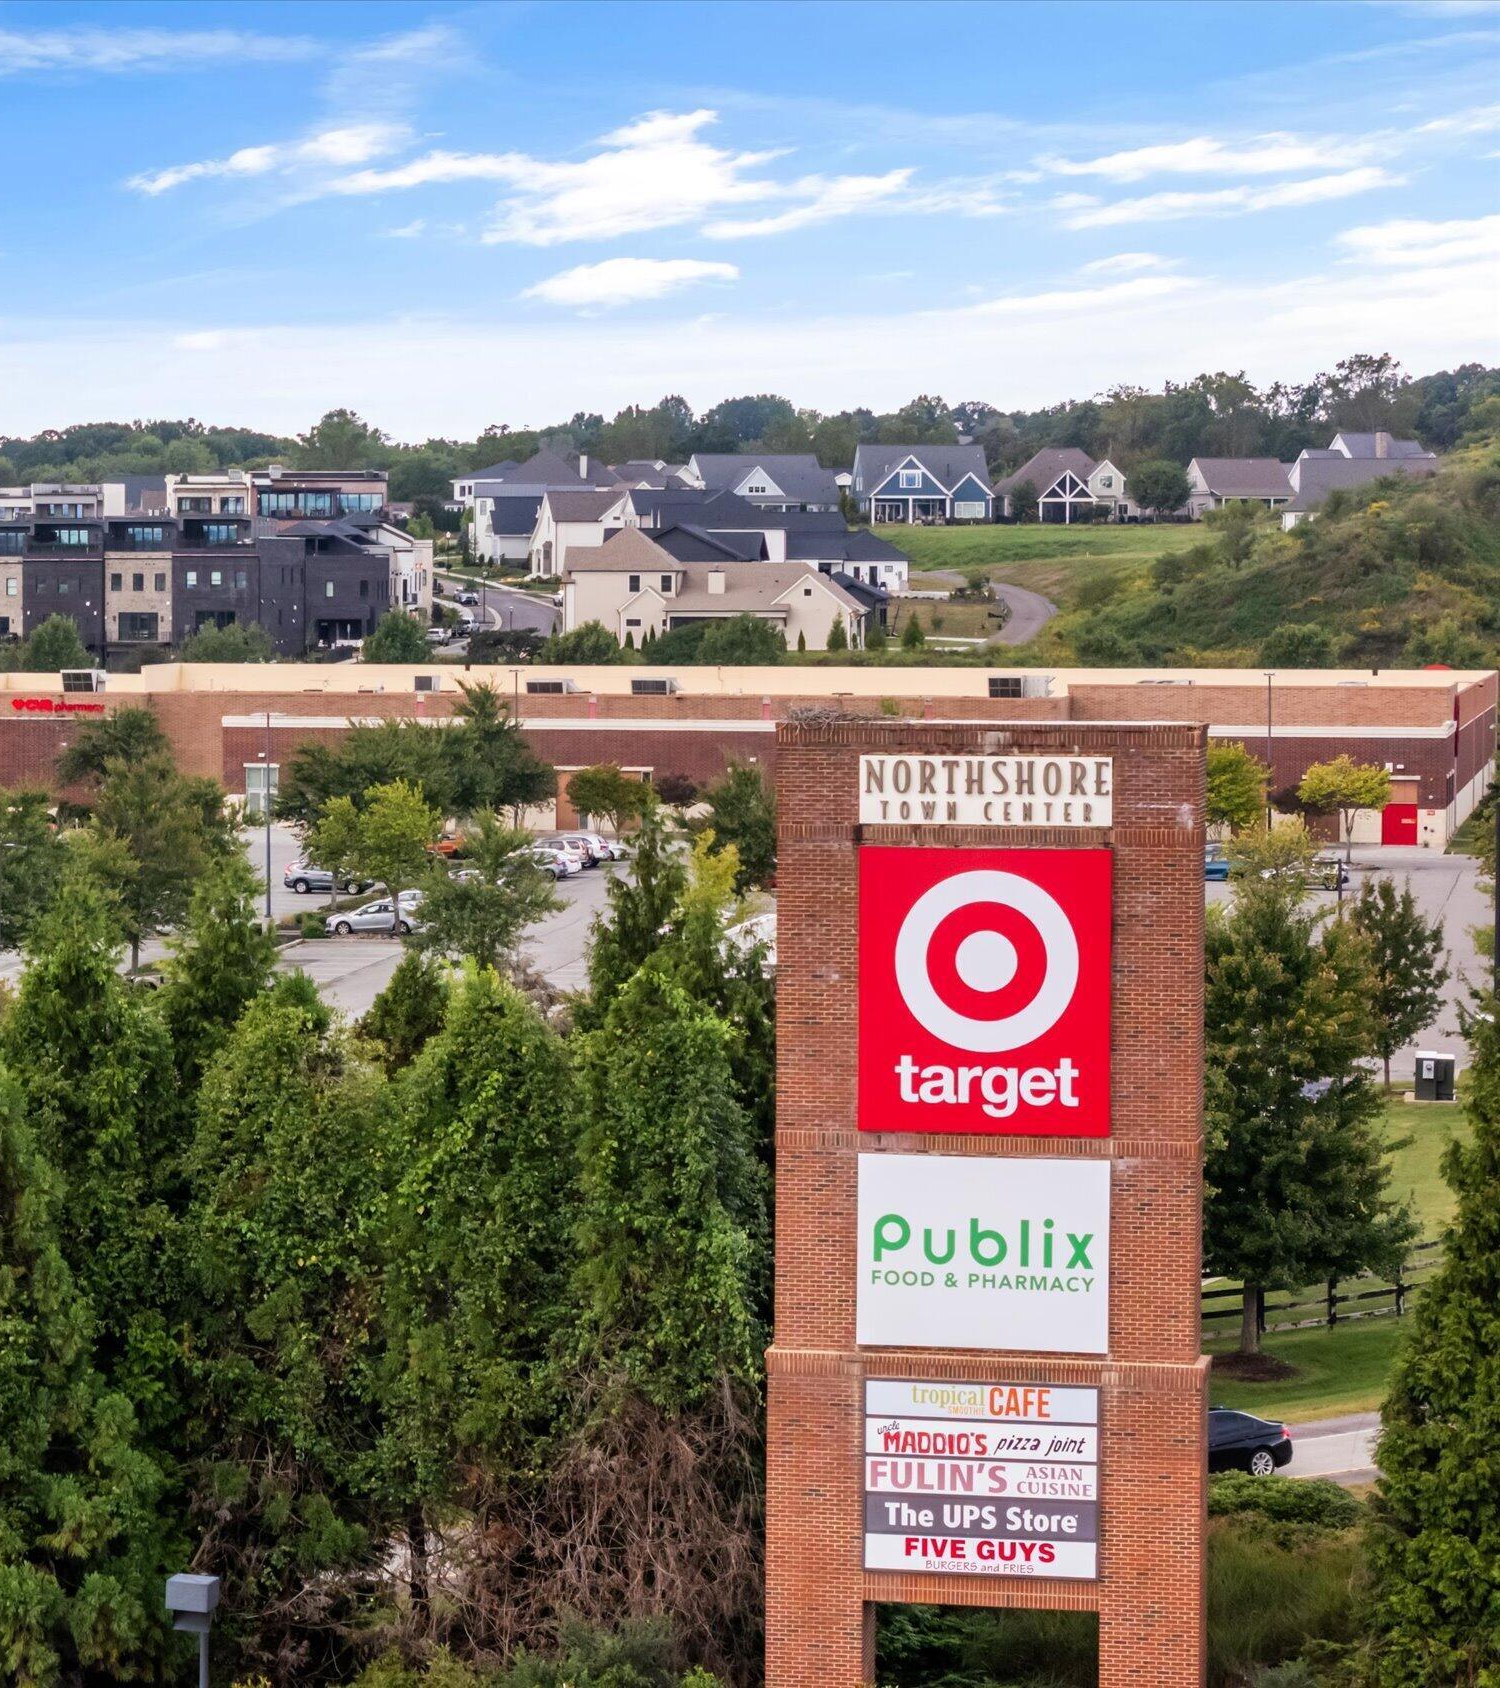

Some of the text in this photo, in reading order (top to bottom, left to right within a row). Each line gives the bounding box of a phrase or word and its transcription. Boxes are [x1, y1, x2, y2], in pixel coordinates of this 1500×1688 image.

[54, 701, 105, 713] pharmacy
[864, 759, 1110, 796] NORTHSHORE
[880, 800, 1093, 822] TOWN CENTER
[894, 1054, 1079, 1119] target
[873, 1213, 1094, 1270] Publix
[872, 1270, 1095, 1292] FOOD & PHARMACY
[911, 1384, 1051, 1418] tropical CAFE
[877, 1420, 900, 1435] uncle
[883, 1431, 1086, 1456] MADDIO'S pizza joint
[870, 1461, 1083, 1494] FULIN'S ASIAN
[1017, 1481, 1093, 1497] CUISINE
[885, 1502, 1077, 1533] The UPS Store
[905, 1537, 1056, 1563] FIVE GUYS
[925, 1560, 1034, 1574] BURGERS and FRIES
